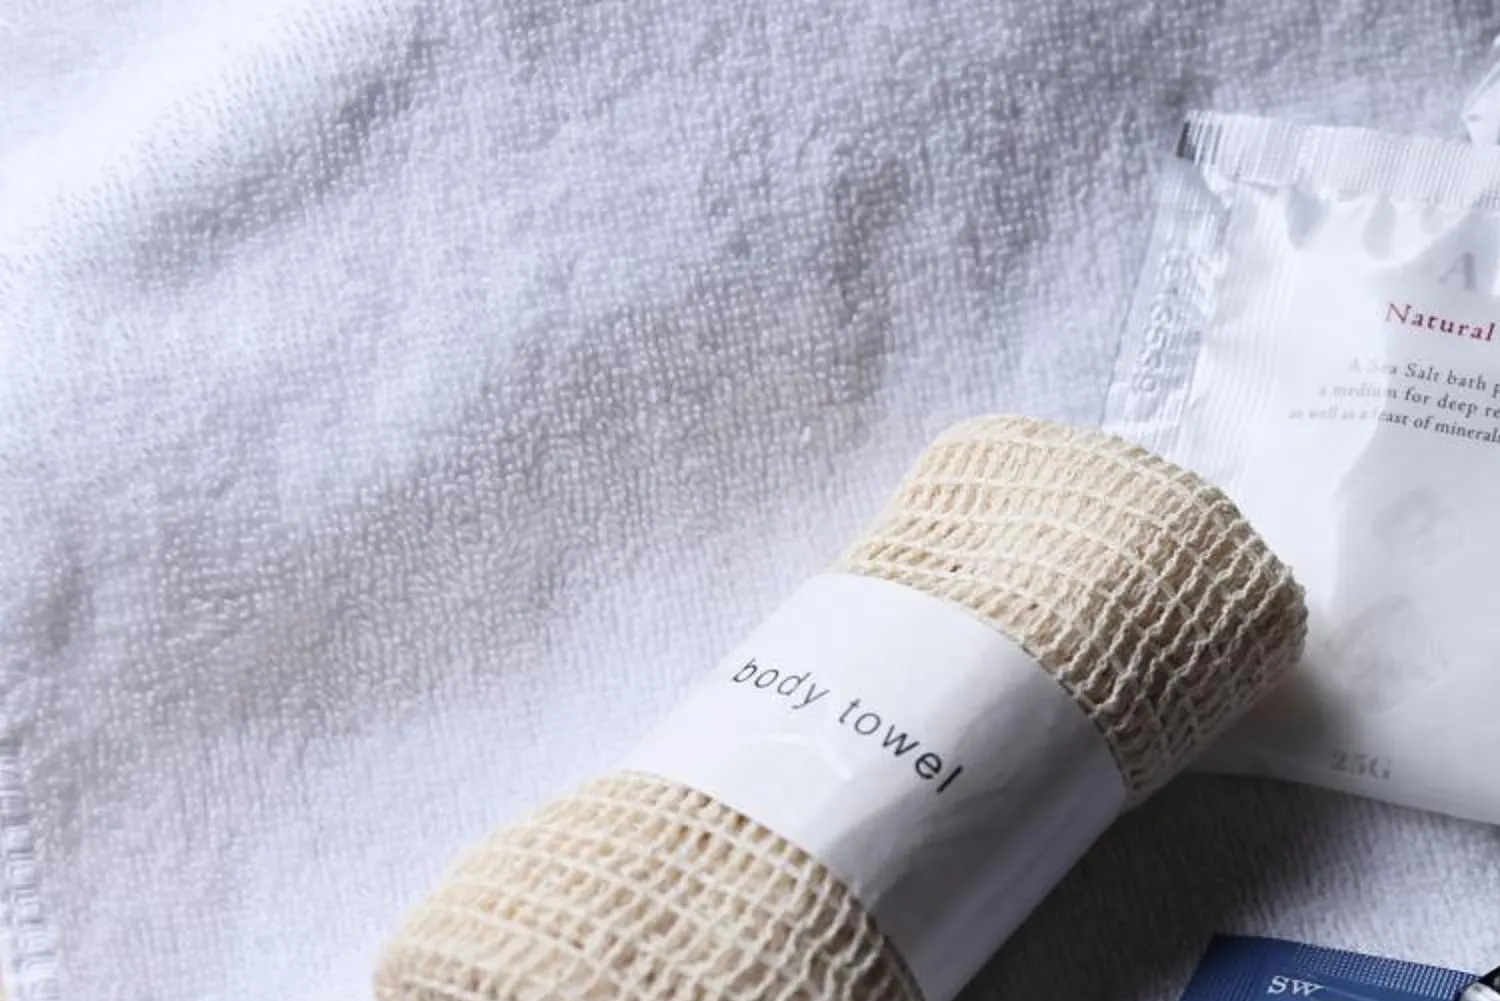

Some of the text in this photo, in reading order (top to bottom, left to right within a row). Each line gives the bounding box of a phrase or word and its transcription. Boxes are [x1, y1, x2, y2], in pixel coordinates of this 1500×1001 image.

[1385, 302, 1496, 342] Natural
[1403, 361, 1441, 383] Salt
[1446, 368, 1487, 392] bath
[1403, 384, 1433, 406] for
[1436, 393, 1478, 419] deep
[1412, 414, 1435, 430] of
[732, 656, 965, 794] body towel
